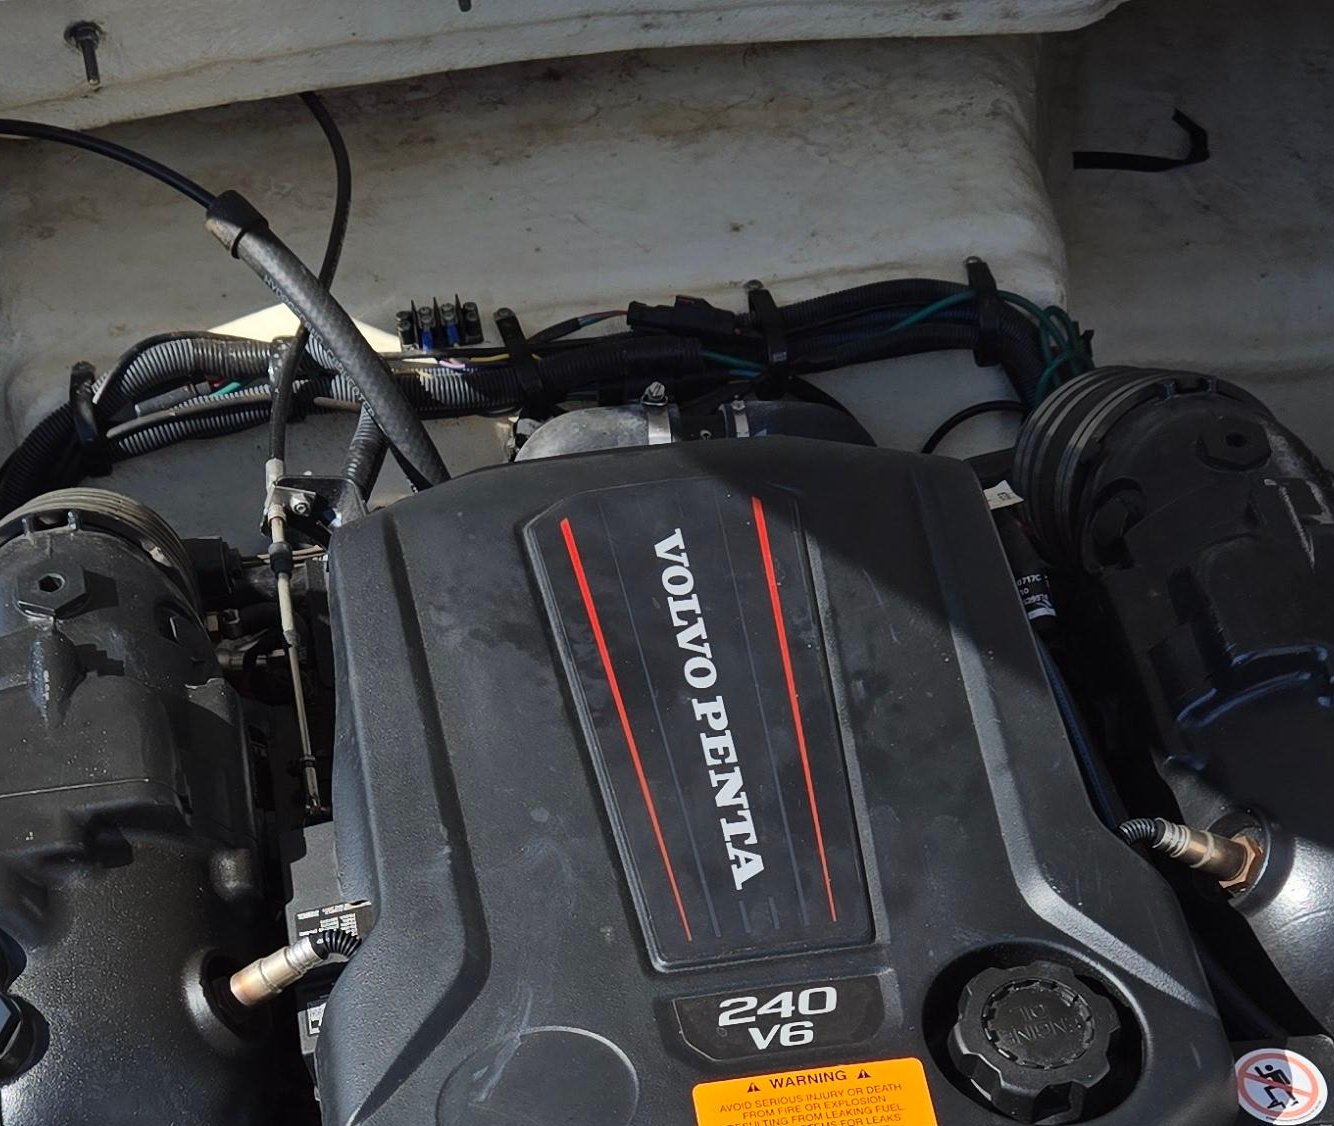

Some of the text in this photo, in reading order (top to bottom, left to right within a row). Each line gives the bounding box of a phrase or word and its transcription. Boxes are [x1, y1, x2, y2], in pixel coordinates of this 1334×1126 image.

[651, 528, 766, 890] VOLVO PENTA
[718, 987, 837, 1027] 240
[748, 1021, 814, 1050] V6
[769, 1070, 847, 1090] WARNING
[719, 1083, 902, 1113] AVOID SERIOUS INJURY OR DEATH
[743, 1095, 887, 1120] FROM FIRE OR EXPLOSION
[791, 1112, 823, 1124] FROM
[825, 1107, 873, 1120] LEAKING
[865, 1113, 902, 1126] LEAKS
